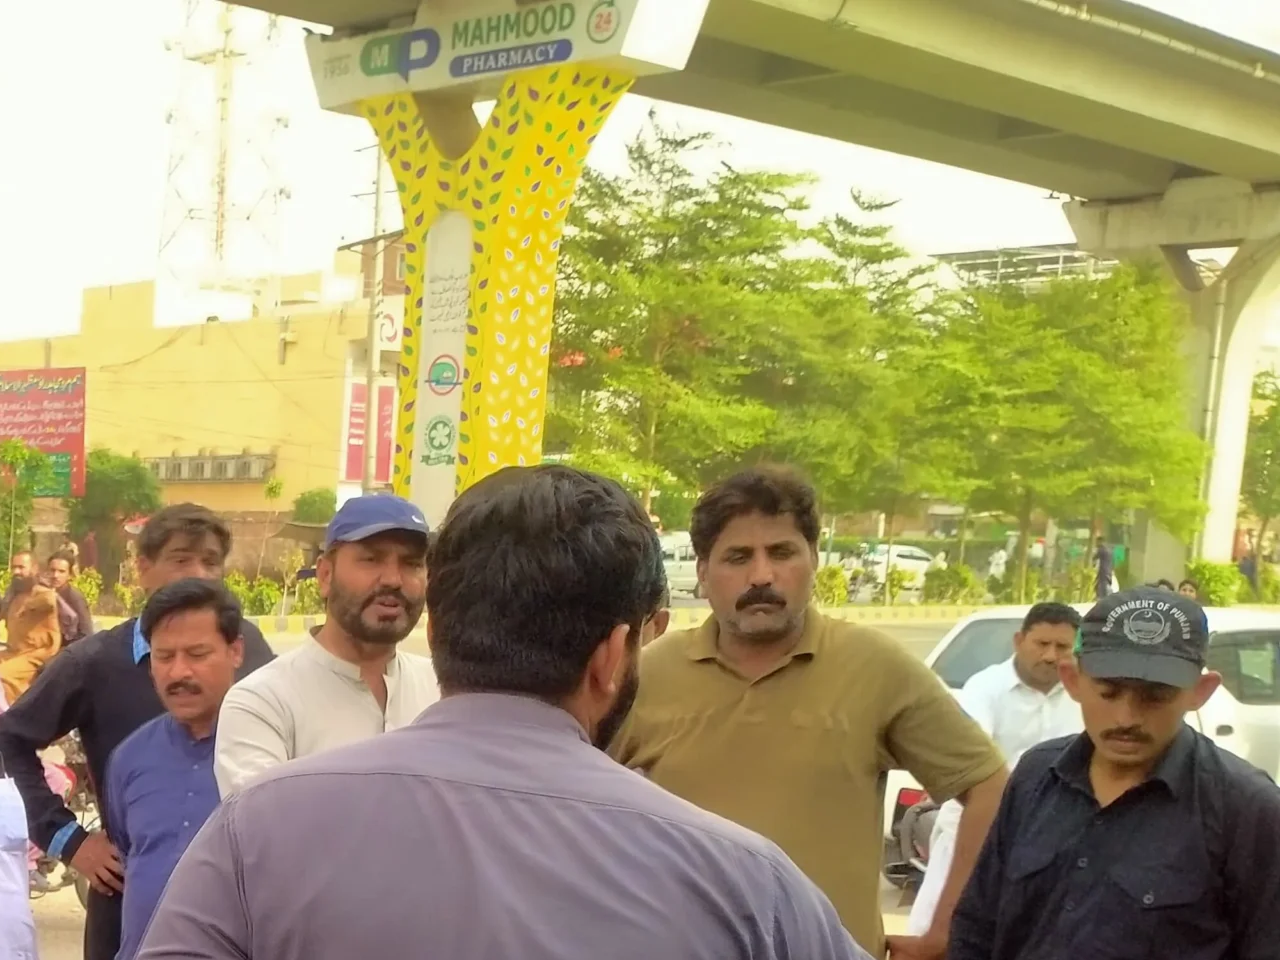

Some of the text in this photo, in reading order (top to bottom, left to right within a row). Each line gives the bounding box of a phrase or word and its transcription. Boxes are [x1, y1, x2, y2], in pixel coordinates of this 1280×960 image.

[451, 2, 575, 50] MAHMOOD
[595, 11, 613, 31] 24
[462, 43, 558, 74] PHARMACY
[1102, 600, 1190, 639] GOVERNMENT OF PUNJAB
